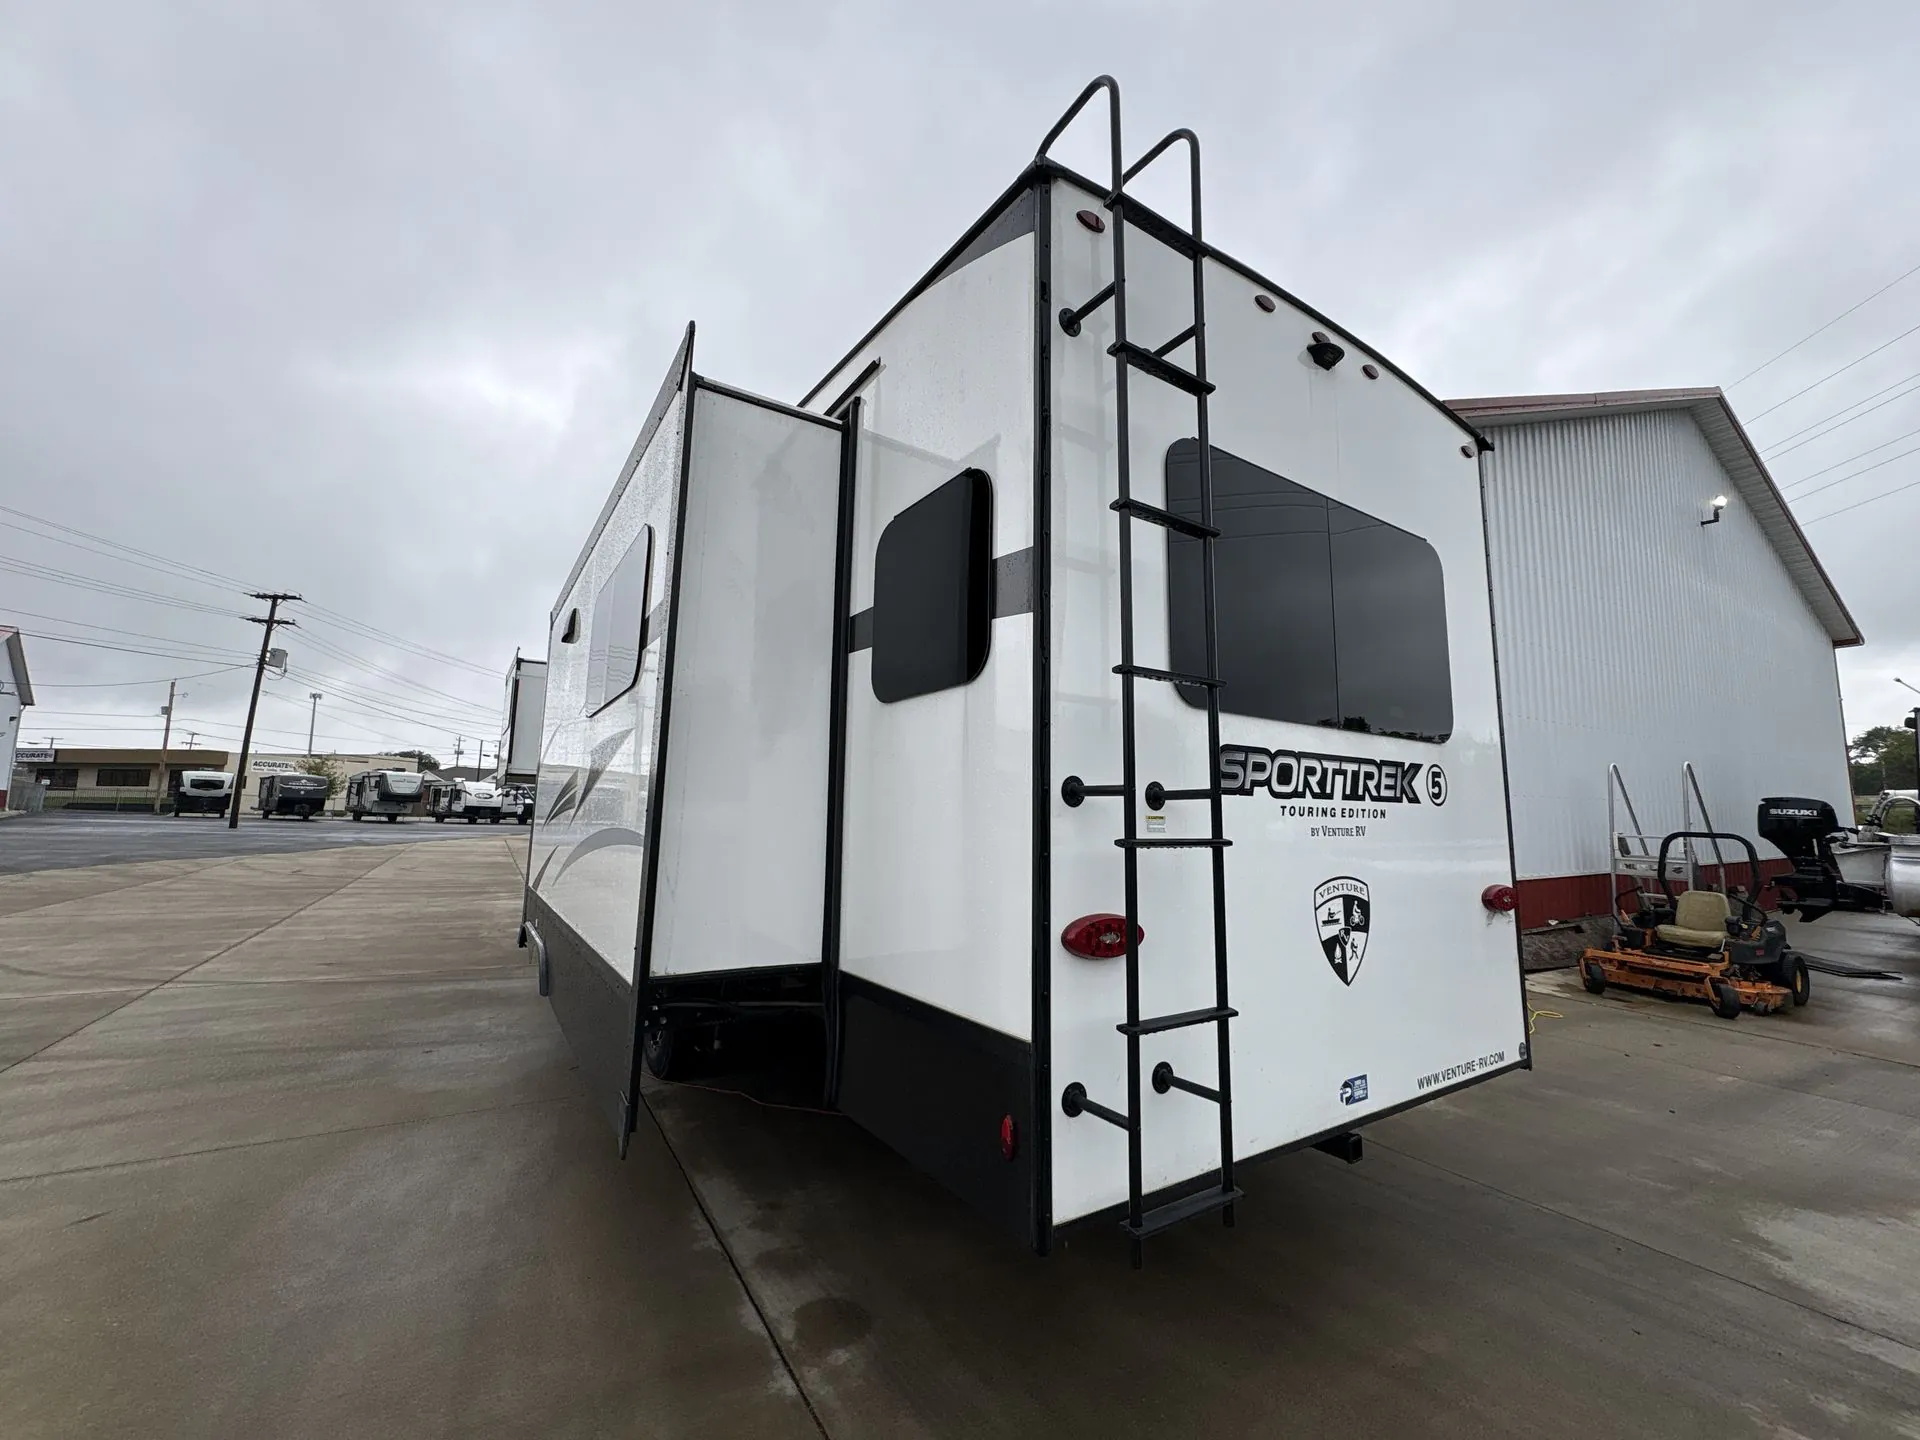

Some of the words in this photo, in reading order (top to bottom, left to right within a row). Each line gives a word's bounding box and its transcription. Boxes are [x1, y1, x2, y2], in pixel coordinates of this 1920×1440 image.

[252, 761, 289, 769] ACCURATE
[1220, 744, 1423, 803] SPORTTREK
[1280, 805, 1337, 818] TOURING
[1341, 807, 1387, 819] EDITION
[1769, 808, 1818, 817] SUZUKI
[1355, 825, 1366, 837] RV
[1319, 883, 1366, 899] VENTURE
[1417, 1051, 1505, 1090] WWW.VENTURE-RV.COM
